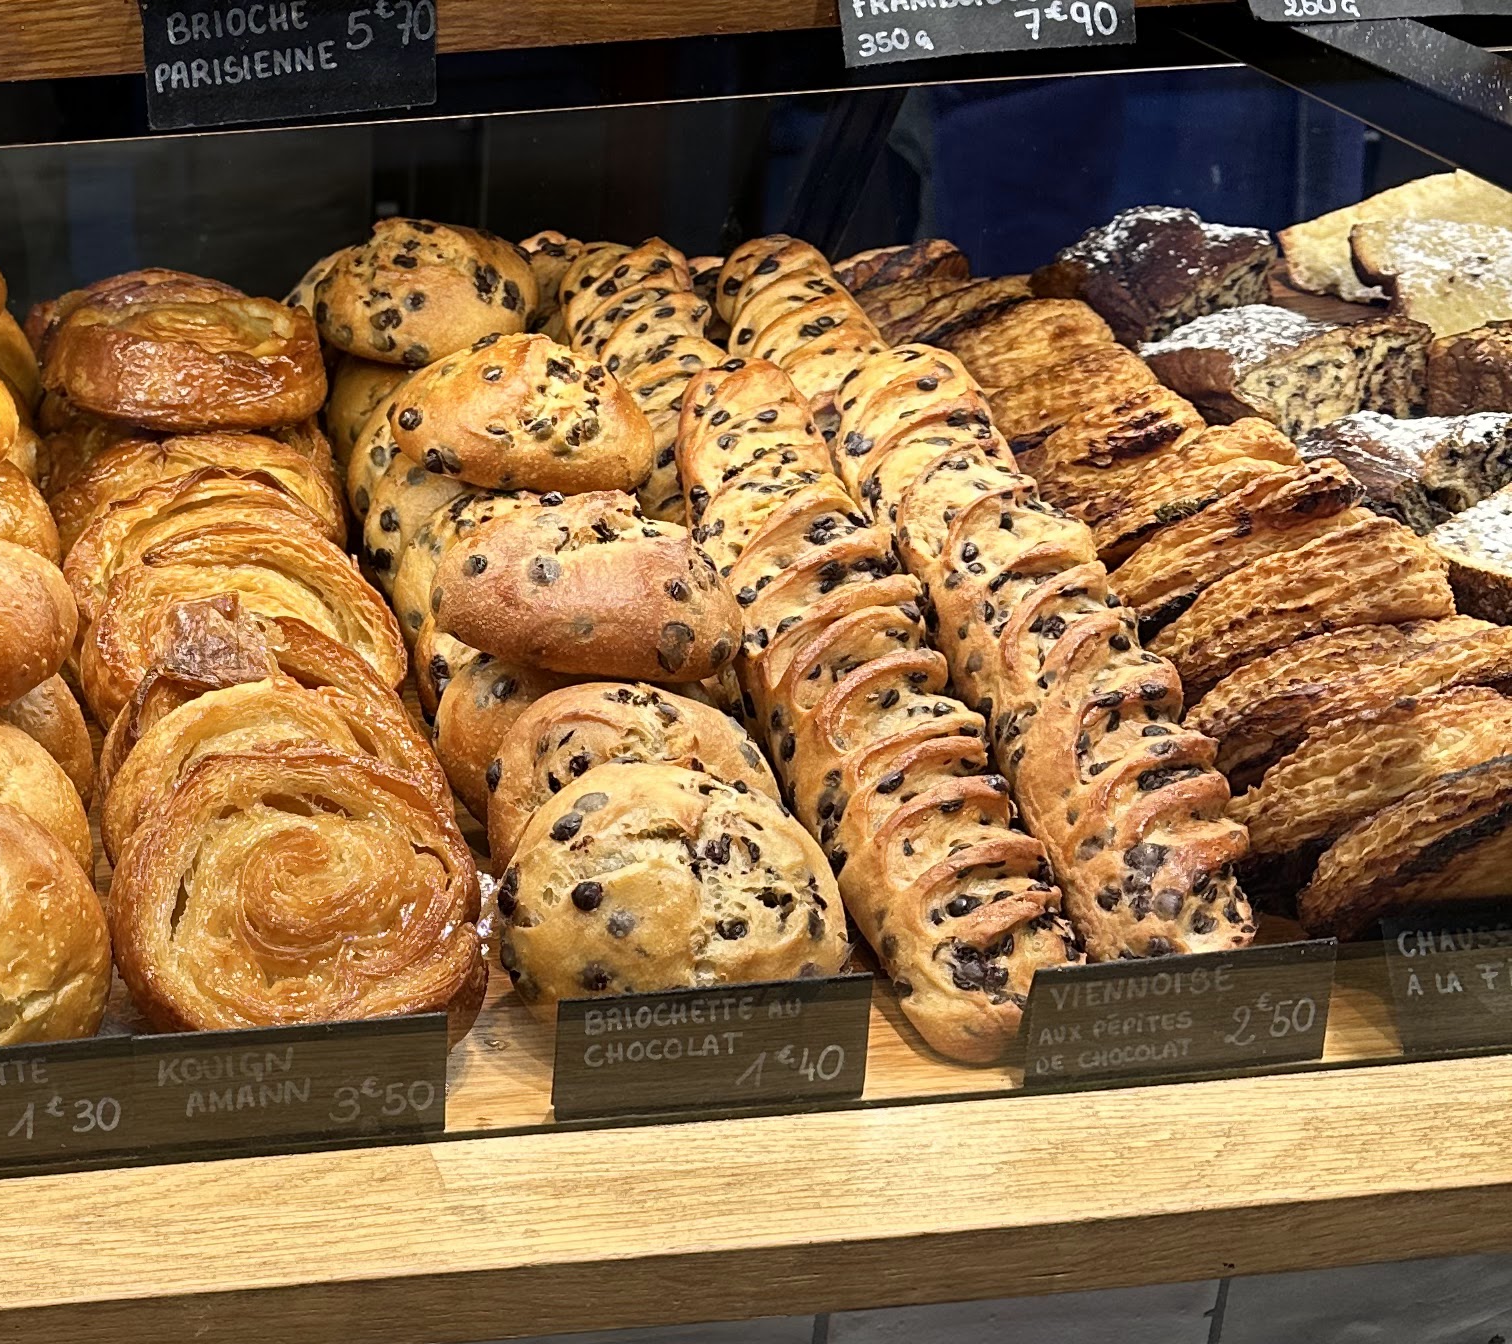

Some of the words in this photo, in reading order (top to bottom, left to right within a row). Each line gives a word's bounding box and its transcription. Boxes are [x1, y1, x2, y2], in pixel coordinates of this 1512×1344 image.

[166, 0, 310, 46] BRIOCHE
[1014, 0, 1118, 40] 7€90
[154, 40, 338, 93] PARISIENNE
[1049, 963, 1235, 1011] VIENNOISE
[1435, 970, 1464, 994] LA
[584, 996, 754, 1036] BRIOCHETTE
[767, 997, 802, 1020] AU
[1039, 1023, 1082, 1047] AUX
[1093, 1010, 1193, 1039] PÉPITES
[1224, 991, 1316, 1047] 2€50
[157, 1046, 294, 1087] KOUIGN
[583, 1031, 744, 1068] CHOCOLAT
[735, 1044, 845, 1088] 1€40
[1036, 1054, 1065, 1075] DE
[1078, 1038, 1193, 1069] CHOCOLAT
[7, 1095, 122, 1140] 1€30
[185, 1077, 311, 1118] AMANN
[328, 1076, 435, 1123] 3€50
